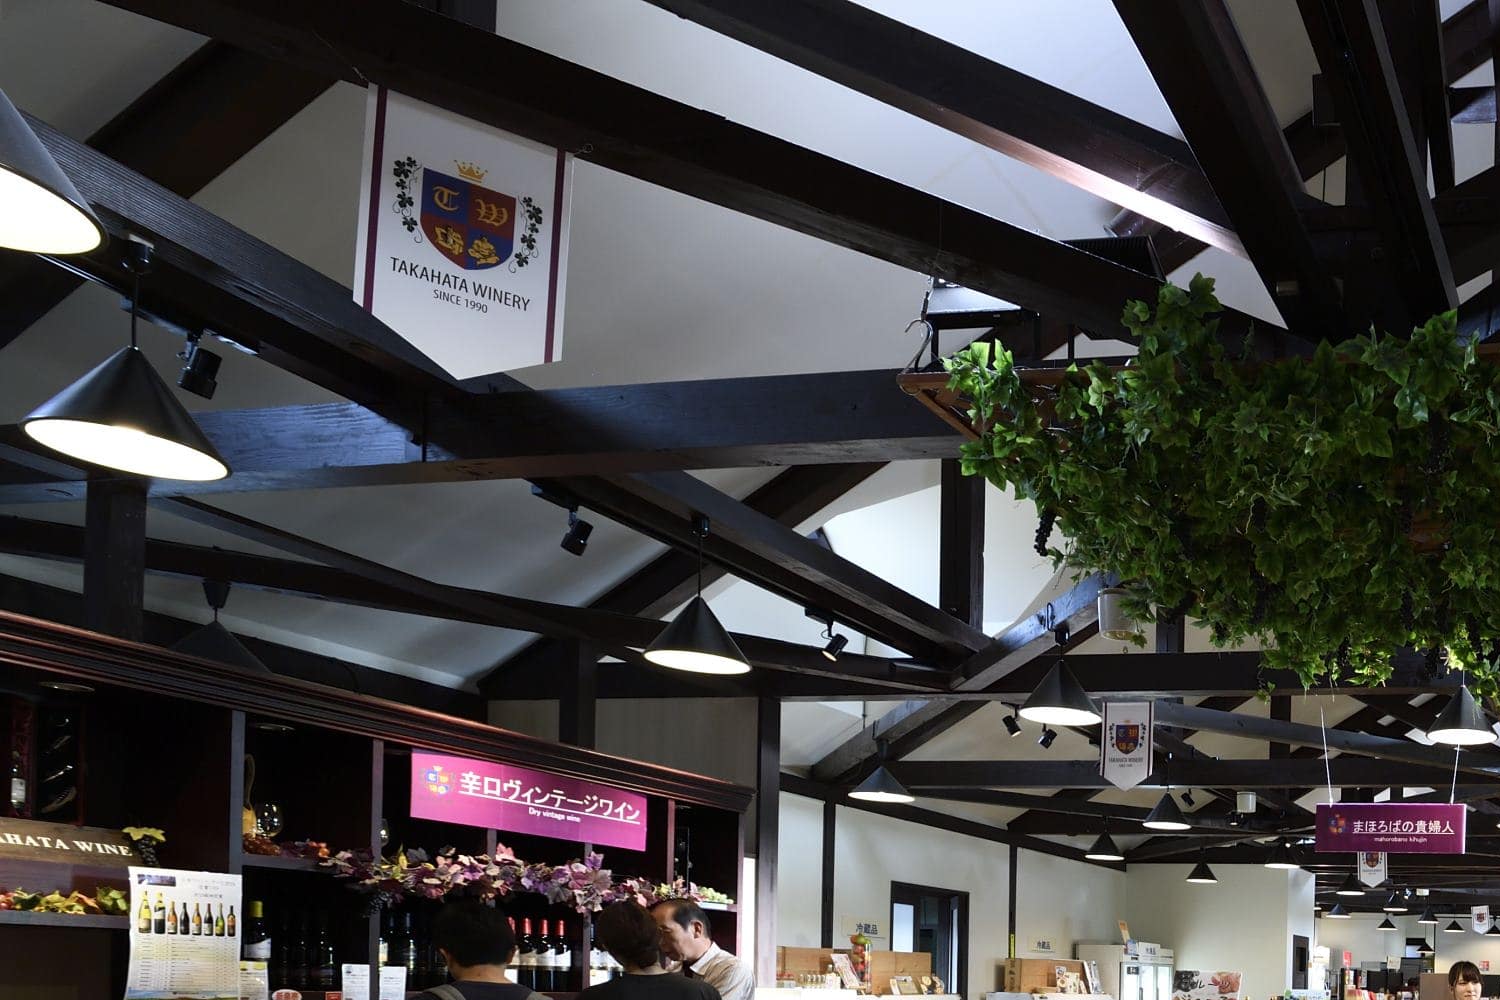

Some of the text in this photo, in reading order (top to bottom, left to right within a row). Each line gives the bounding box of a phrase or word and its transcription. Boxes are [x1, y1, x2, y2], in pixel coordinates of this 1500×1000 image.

[390, 256, 530, 312] TAKAHATA WINERY
[433, 289, 488, 313] SINCE 1990
[460, 771, 640, 821] 辛口ヴィンテージワイン
[528, 807, 541, 817] Dry
[542, 809, 565, 821] vintage
[1353, 820, 1454, 833] まほろばの貴婦人
[72, 840, 133, 857] WINE
